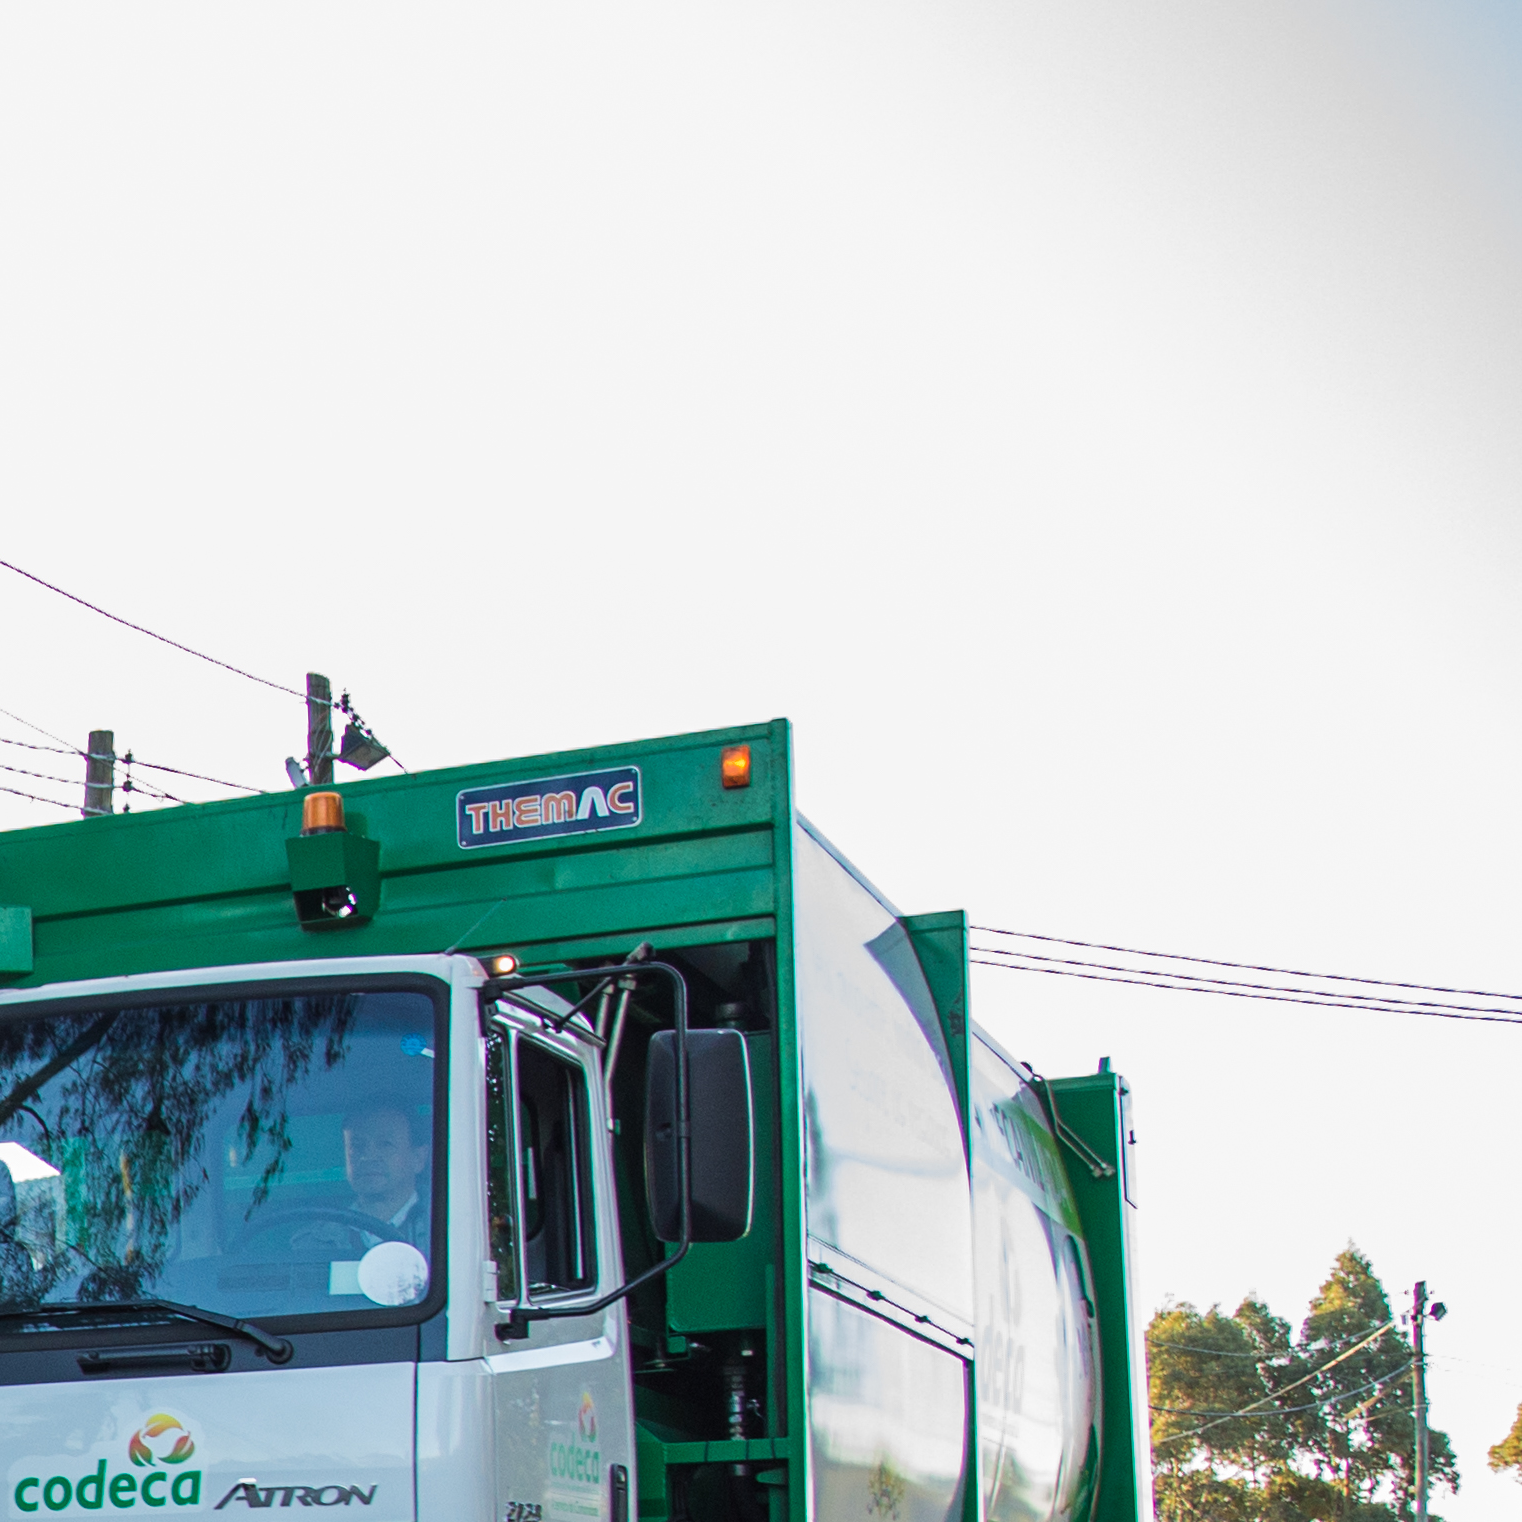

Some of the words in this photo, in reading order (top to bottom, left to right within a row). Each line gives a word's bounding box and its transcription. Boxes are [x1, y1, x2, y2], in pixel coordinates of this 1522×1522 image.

[465, 781, 635, 835] THEMAC
[550, 1431, 600, 1484] codeca
[14, 1458, 202, 1513] codeca
[213, 1477, 378, 1510] ATRON
